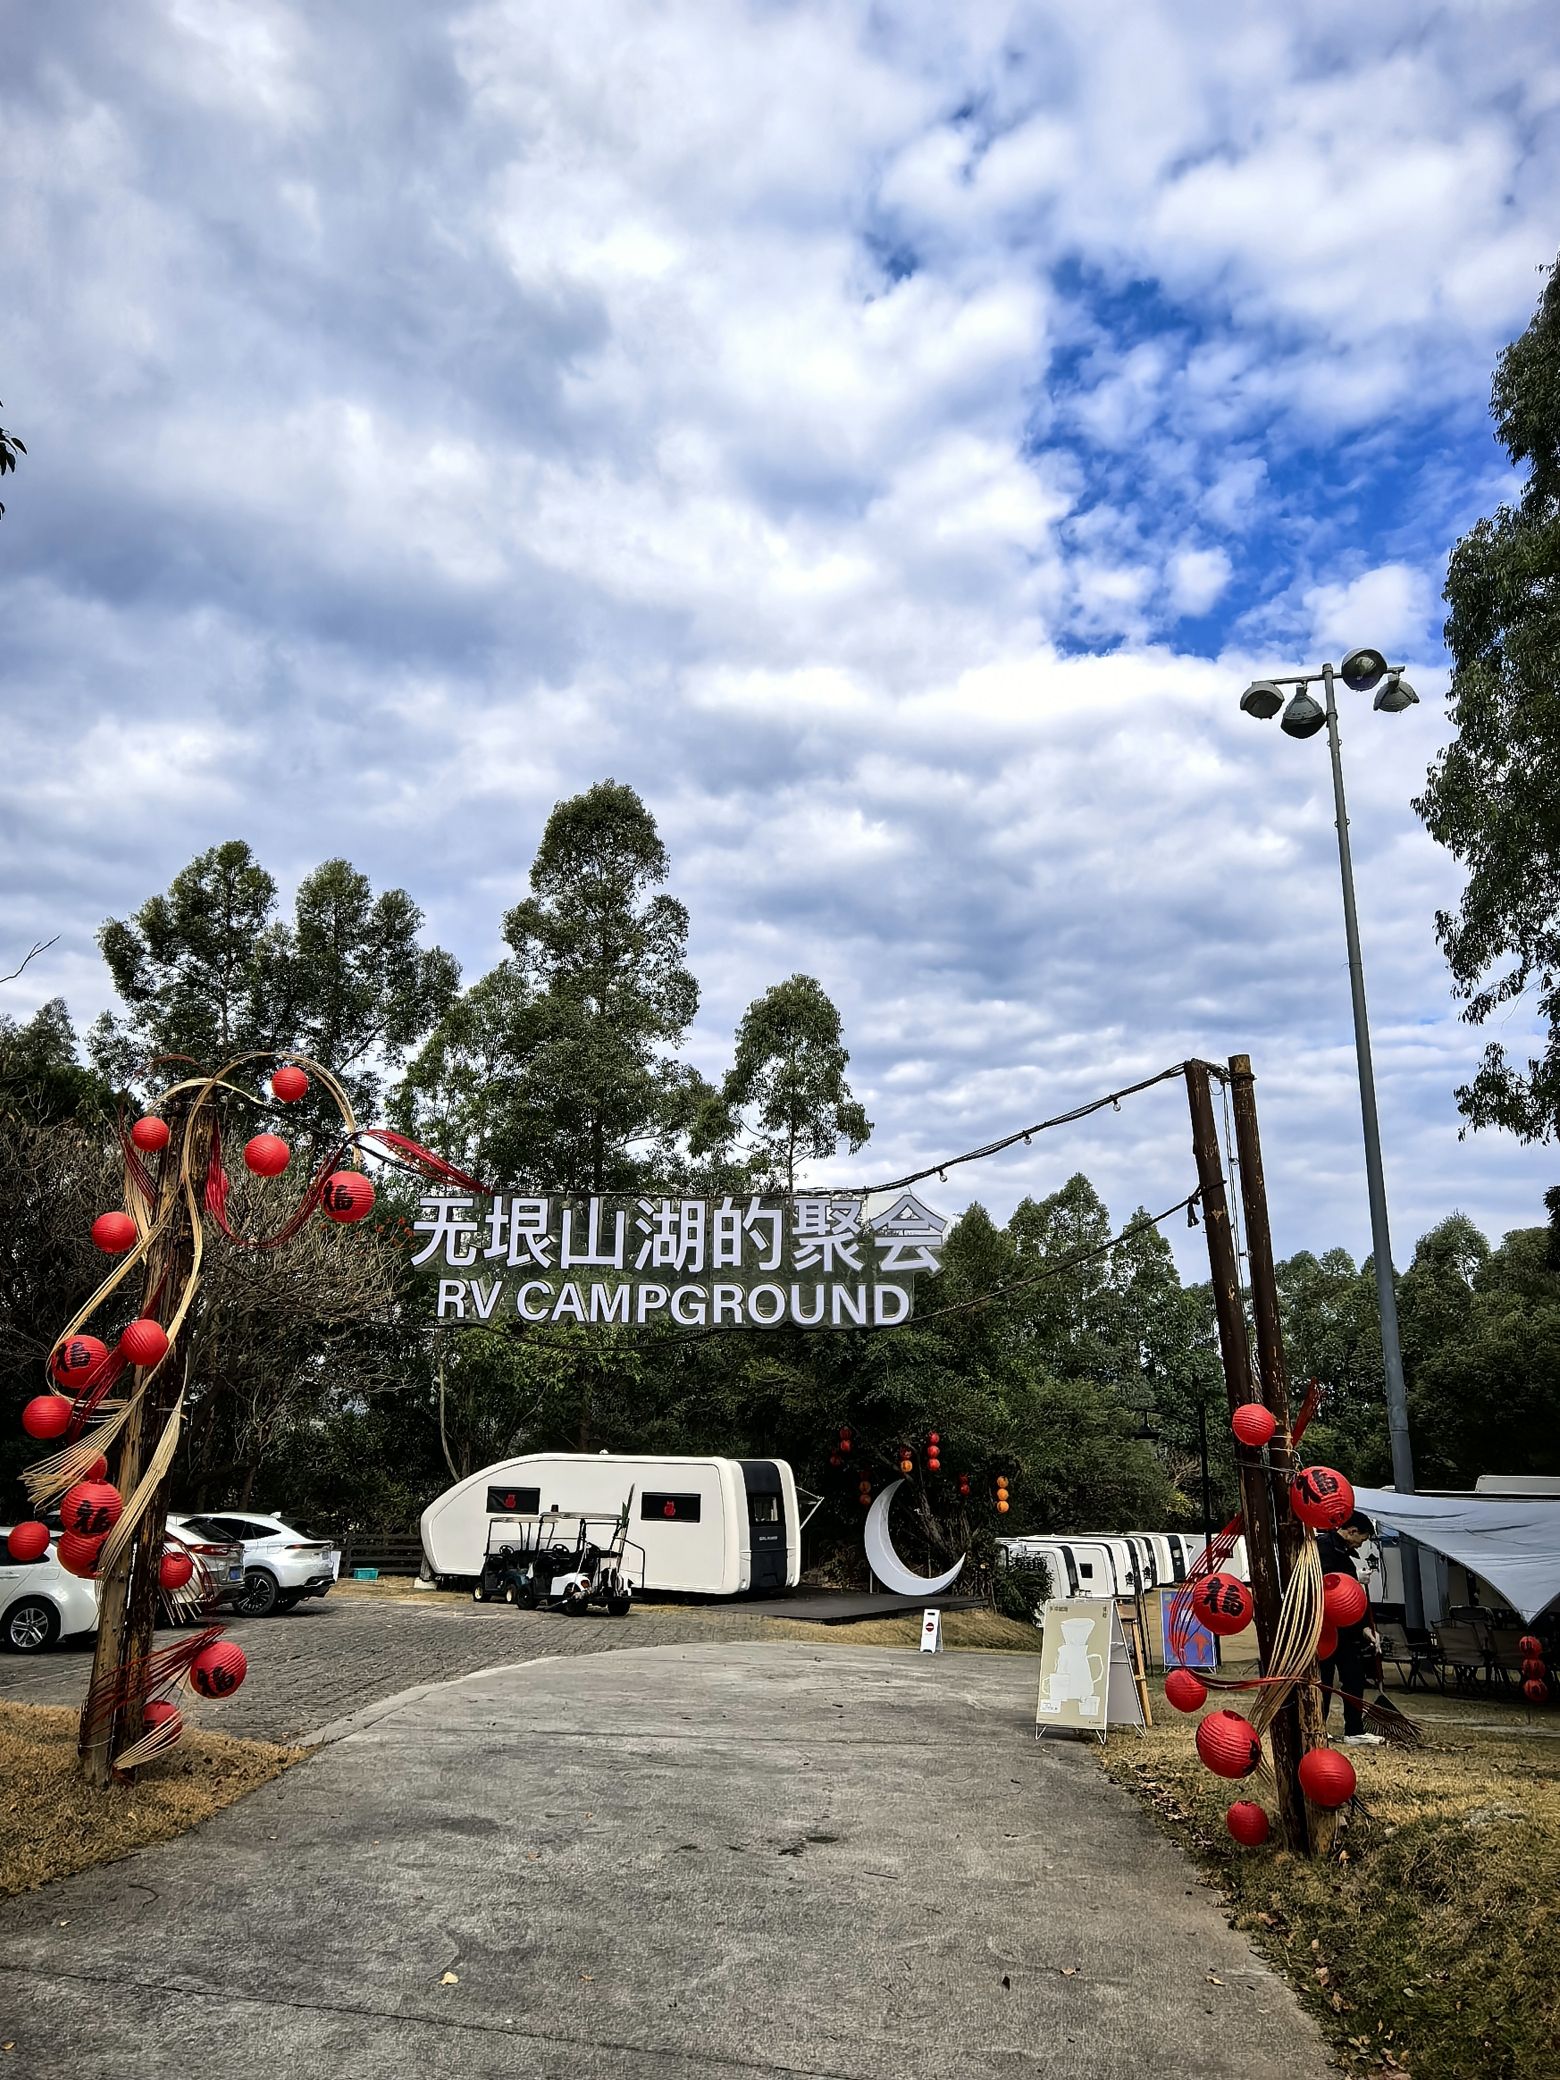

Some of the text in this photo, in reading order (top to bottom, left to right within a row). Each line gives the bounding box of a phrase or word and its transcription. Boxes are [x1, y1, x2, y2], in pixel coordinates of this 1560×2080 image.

[323, 1180, 353, 1212] 福
[410, 1194, 949, 1274] 无垠山湖的聚会
[437, 1279, 910, 1325] RV CAMPGROUND
[56, 1342, 90, 1373] 福
[1296, 1469, 1339, 1505] 福
[73, 1500, 112, 1535] 福
[1203, 1576, 1245, 1616] 福
[196, 1665, 235, 1697] 福
